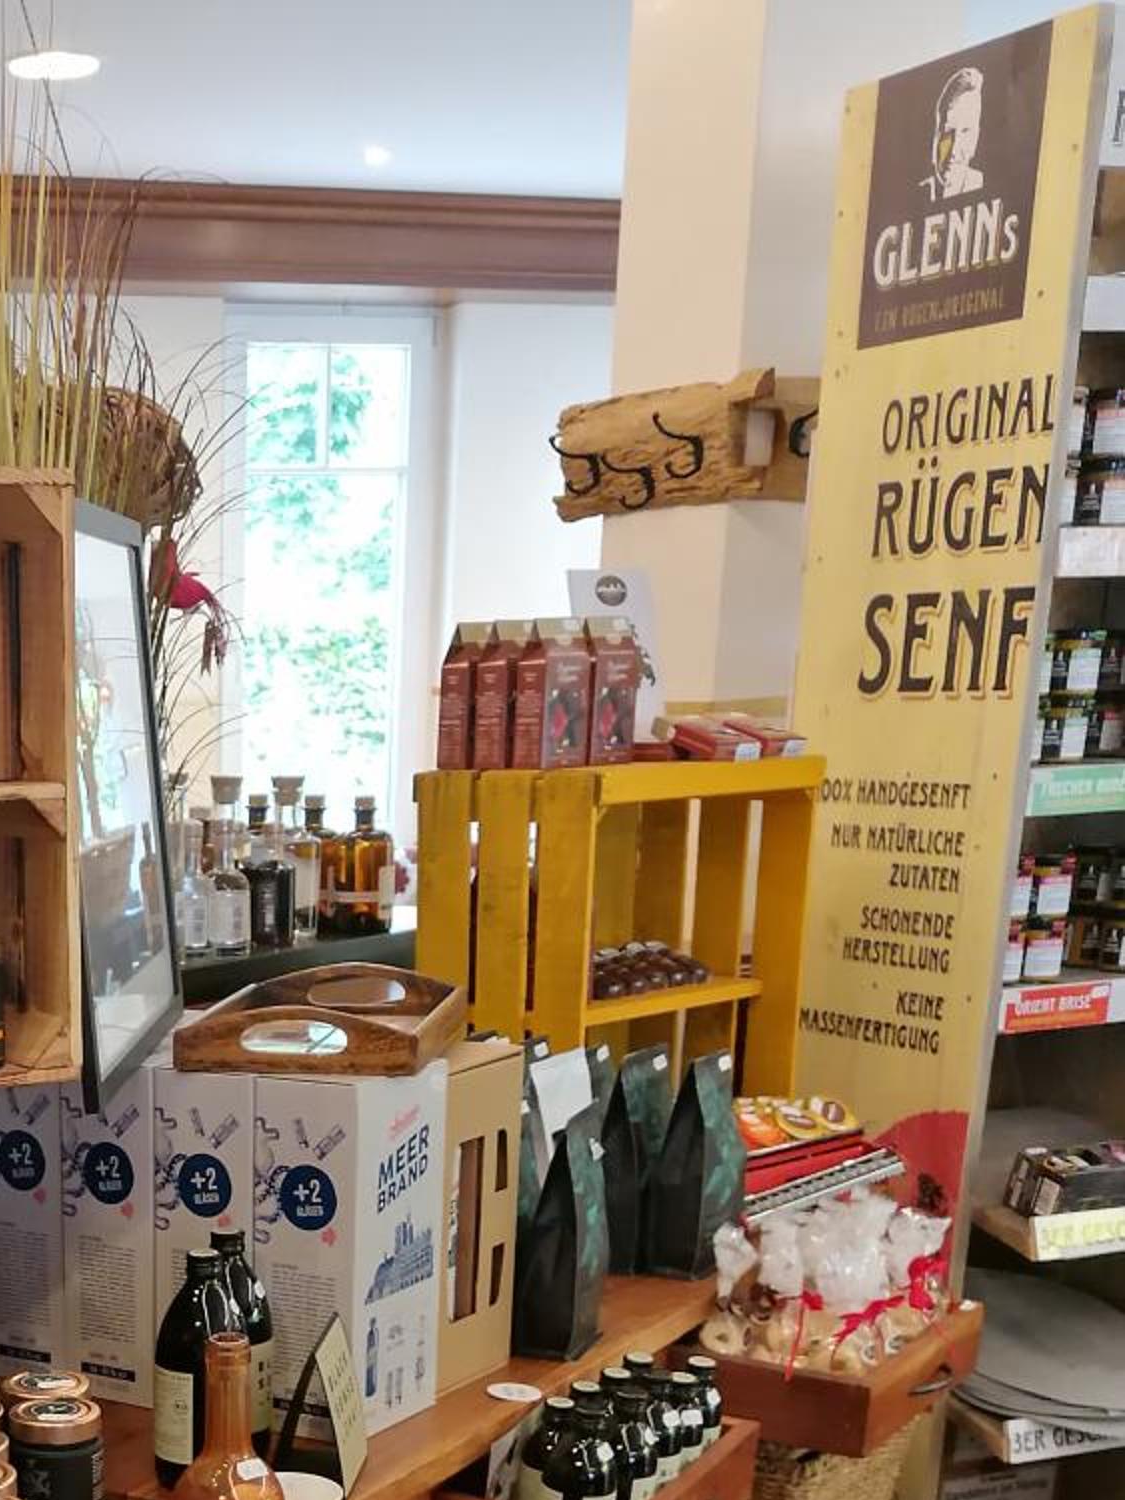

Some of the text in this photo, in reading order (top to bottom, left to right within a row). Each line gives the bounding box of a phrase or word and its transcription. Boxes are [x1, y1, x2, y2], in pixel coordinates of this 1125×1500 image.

[882, 374, 1054, 454] ORIGINAL
[871, 455, 1051, 558] RÜGEN
[857, 586, 1036, 696] SENF
[857, 779, 971, 810] HANDGESENFT
[831, 822, 965, 857] NUR NATÜRLICHE
[889, 862, 960, 894] ZUTATEN
[860, 905, 955, 940] SCHONENDE
[842, 937, 950, 974] HERSTELLUNG
[895, 991, 944, 1021] KEINE
[799, 1007, 939, 1056] MASSENFERTIGUNG
[8, 1143, 34, 1165] +2
[96, 1155, 121, 1179] +2
[378, 1123, 429, 1190] MEER
[190, 1166, 218, 1191] +2
[292, 1178, 322, 1203] +2
[377, 1154, 428, 1214] BRAND
